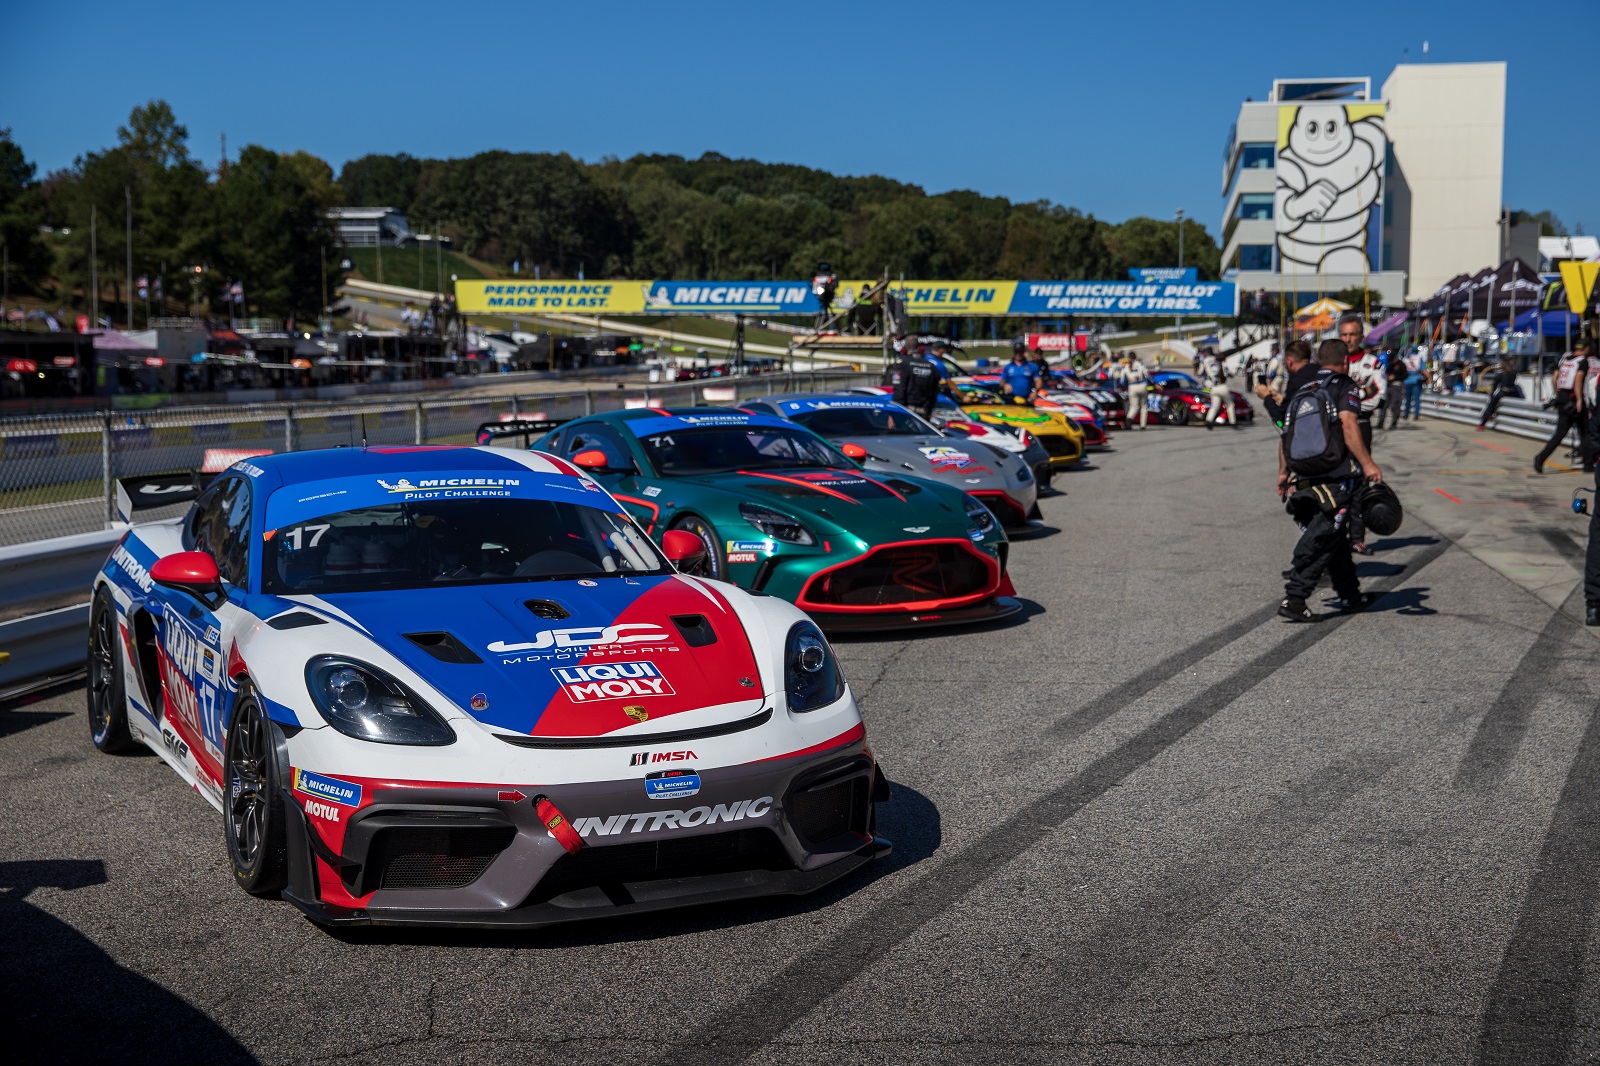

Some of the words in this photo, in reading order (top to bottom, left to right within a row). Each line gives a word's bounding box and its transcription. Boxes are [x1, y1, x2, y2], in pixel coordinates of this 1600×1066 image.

[484, 285, 613, 295] PERFORMANCE
[674, 287, 808, 304] MICHELIN
[1029, 284, 1064, 297] THE
[1066, 284, 1157, 297] MICHELIN
[1163, 284, 1219, 297] PILOT
[488, 297, 537, 307] MADE
[543, 297, 562, 307] TO
[566, 297, 608, 307] LAST.
[1046, 297, 1116, 309] FAMILY
[1117, 297, 1145, 309] OF
[1147, 297, 1201, 310] TIRES.
[648, 436, 676, 448] 71
[419, 478, 520, 487] MICHELIN
[298, 490, 348, 503] PORSCHE
[404, 491, 441, 500] PILOT
[444, 489, 512, 498] CHALLENGE
[285, 523, 331, 551] 17
[728, 552, 756, 562] MOTUL
[112, 545, 156, 594] UNITRONIC
[487, 622, 670, 652] JDC
[164, 609, 196, 682] LIQUI
[554, 644, 623, 654] MILLER
[503, 646, 680, 665] MOTORSPORTS
[558, 662, 656, 683] LIQUI
[165, 659, 199, 730] MOLY
[569, 678, 664, 701] MOLY
[199, 681, 217, 742] 17
[651, 750, 699, 763] IMSA
[308, 779, 354, 799] MICHELIN
[664, 780, 694, 788] MICHELIN
[304, 799, 340, 823] MOTUL
